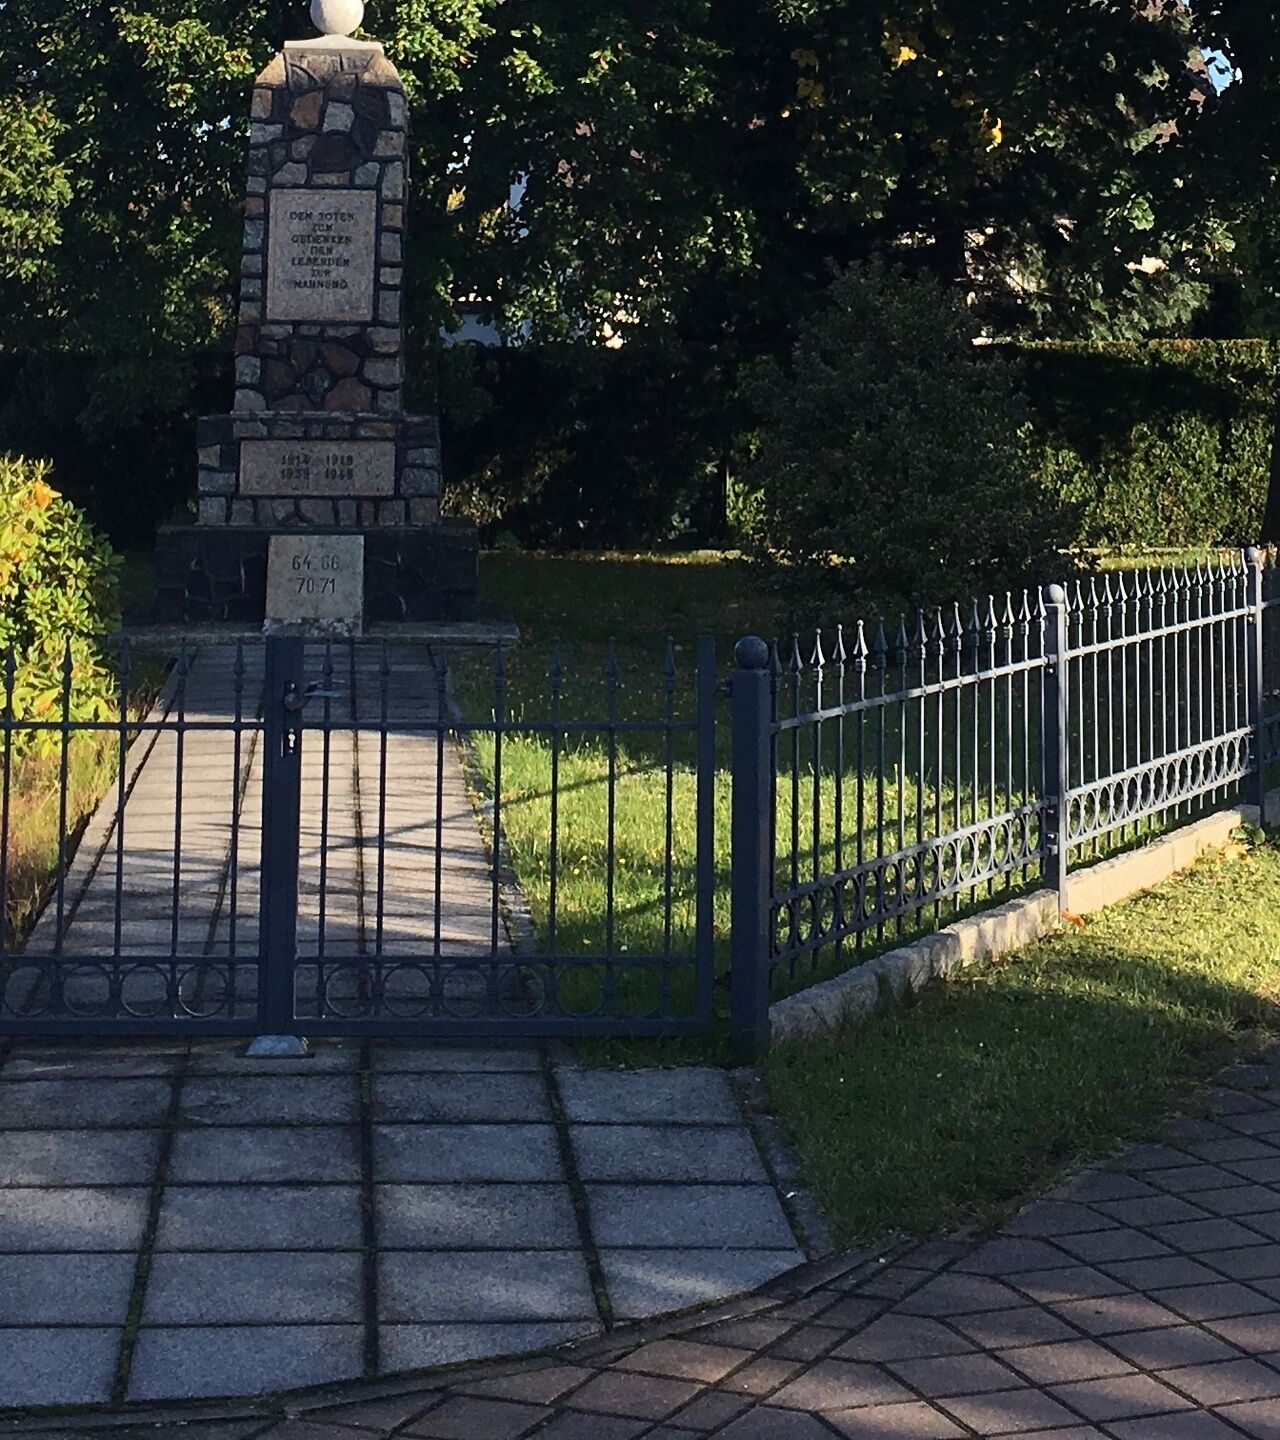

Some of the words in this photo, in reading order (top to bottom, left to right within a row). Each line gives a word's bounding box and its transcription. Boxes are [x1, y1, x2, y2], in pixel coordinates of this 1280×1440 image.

[318, 212, 355, 222] TOTEN
[312, 223, 333, 232] ZUM
[291, 235, 352, 245] GEDENKEN
[310, 245, 333, 255] DEN
[291, 256, 350, 266] LEBENDEN
[311, 268, 331, 278] ZUR
[294, 279, 348, 289] MAHNUNG
[281, 453, 311, 465] 1914
[326, 453, 352, 465] 1918
[292, 554, 312, 570] 64
[321, 554, 340, 570] 66
[296, 577, 315, 594] 70
[320, 577, 336, 594] 71
